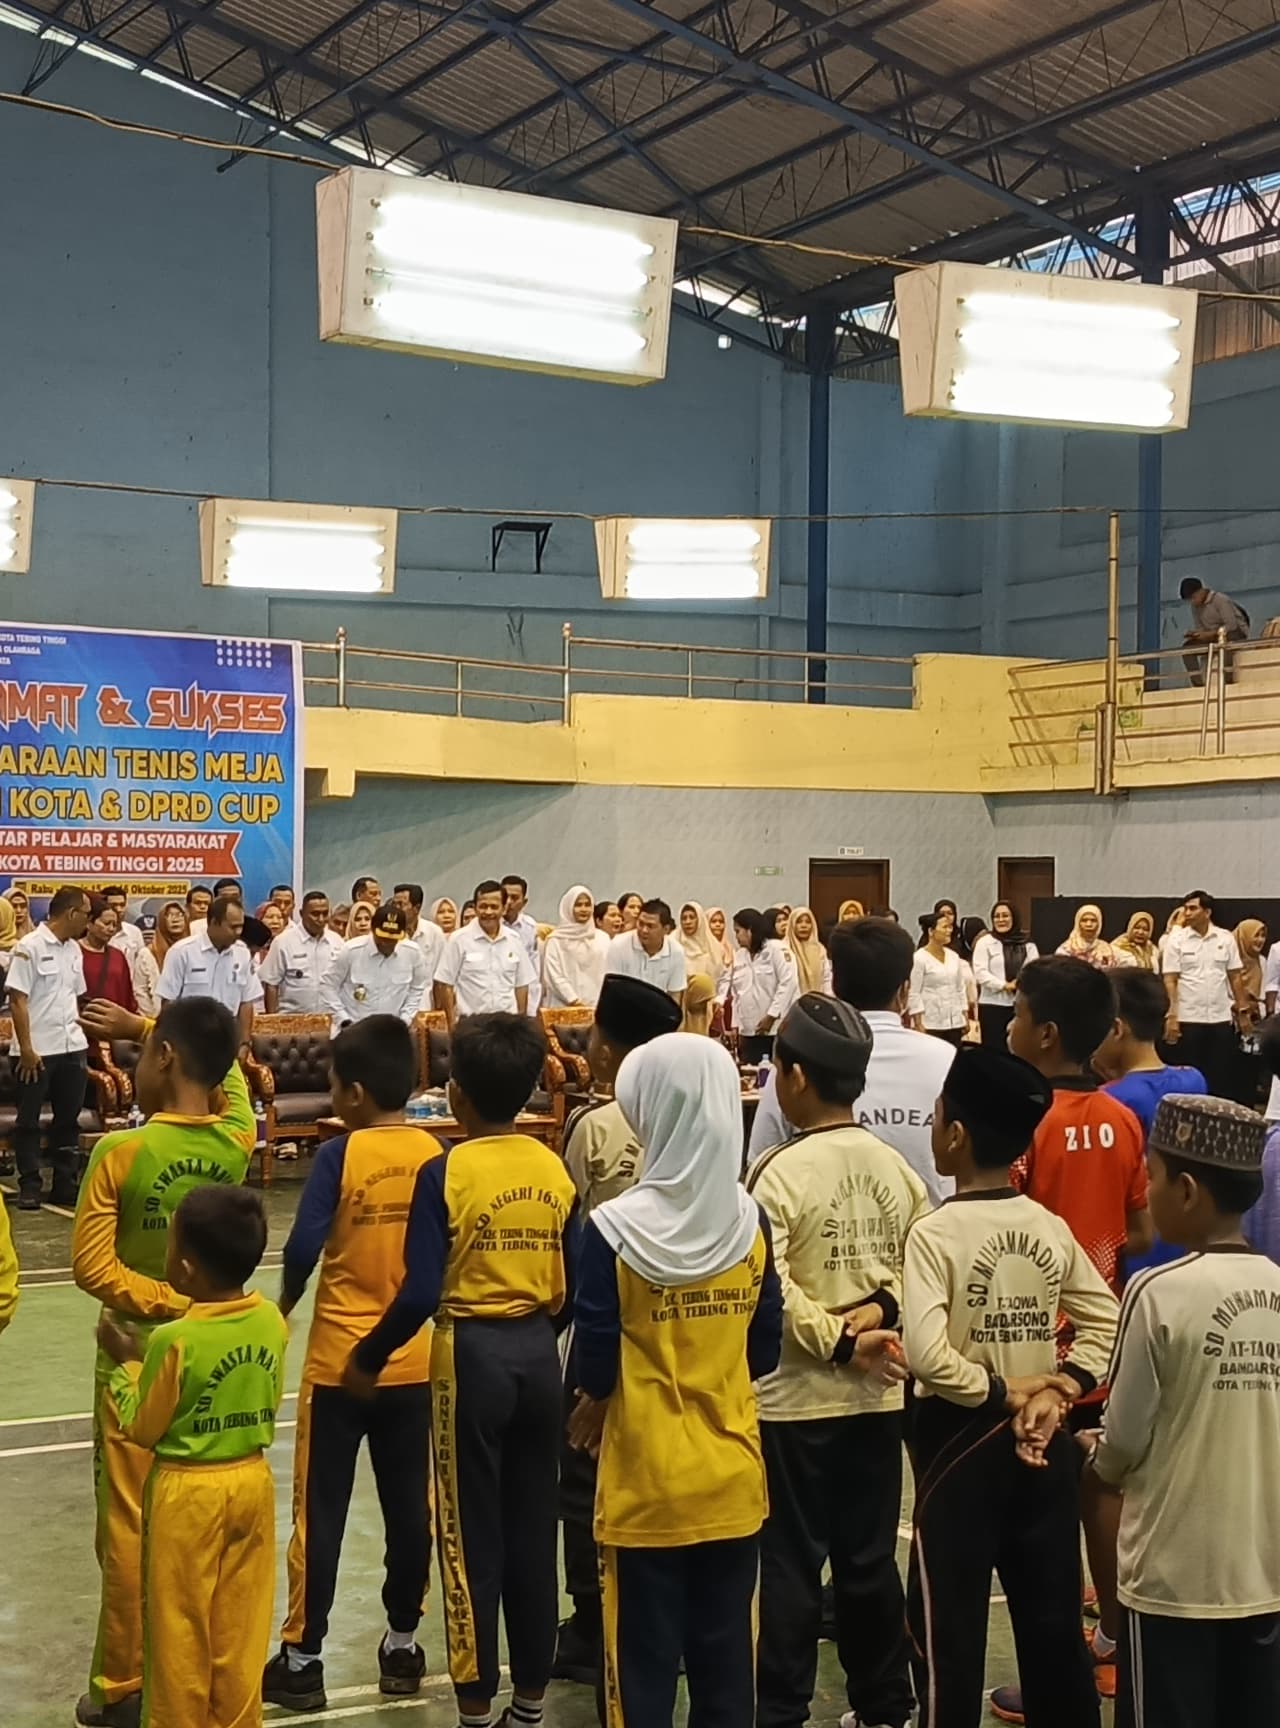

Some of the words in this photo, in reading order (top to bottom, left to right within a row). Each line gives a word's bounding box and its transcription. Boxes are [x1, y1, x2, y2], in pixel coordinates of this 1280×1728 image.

[96, 684, 141, 729] &
[146, 680, 288, 739] SUKSES
[113, 749, 198, 781] TENIS
[204, 752, 285, 783] MEJA
[9, 787, 92, 821] KOTA
[99, 789, 122, 822] &
[128, 790, 213, 823] DPRD
[218, 793, 281, 825] CUP
[31, 831, 104, 849] PELAJAR
[107, 833, 119, 848] &
[121, 833, 227, 851] MASYARAKAT
[44, 855, 104, 872] TEBING
[107, 856, 164, 873] TINGGI
[166, 857, 205, 874] 2025
[31, 884, 54, 894] Rabu
[131, 884, 166, 894] Oktober
[167, 884, 188, 894] 2025
[859, 1107, 935, 1128] ANDEA
[1064, 1122, 1115, 1152] ZIO
[144, 1196, 161, 1213] SD
[142, 1217, 168, 1231] KOTA
[967, 1282, 989, 1308] SD
[970, 1329, 996, 1344] KOTA
[1203, 1331, 1225, 1358] SD
[195, 1395, 213, 1414] SD
[192, 1416, 221, 1434] KOTA
